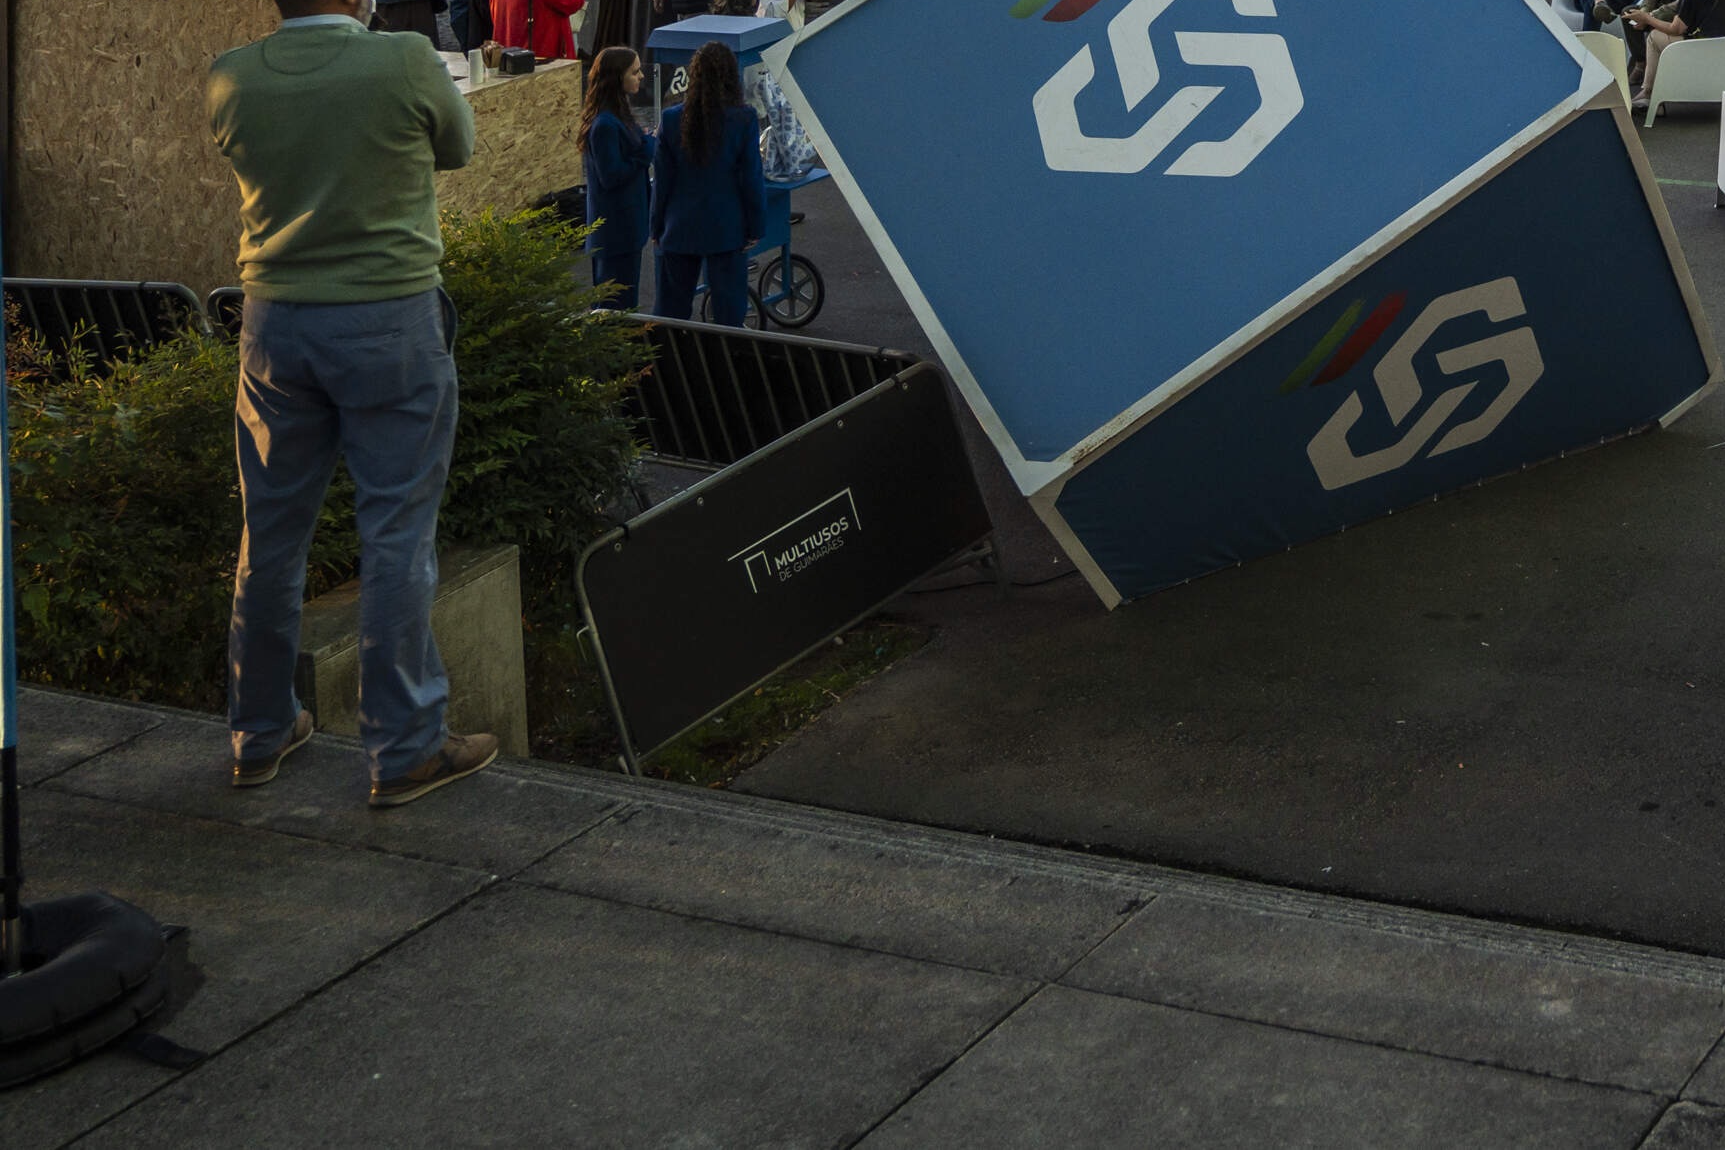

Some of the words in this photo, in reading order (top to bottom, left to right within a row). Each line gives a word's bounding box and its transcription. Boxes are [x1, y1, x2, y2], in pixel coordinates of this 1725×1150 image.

[774, 516, 849, 571] MULTIUSOS
[778, 566, 793, 582] DE
[793, 537, 845, 573] GUIMARÃES
